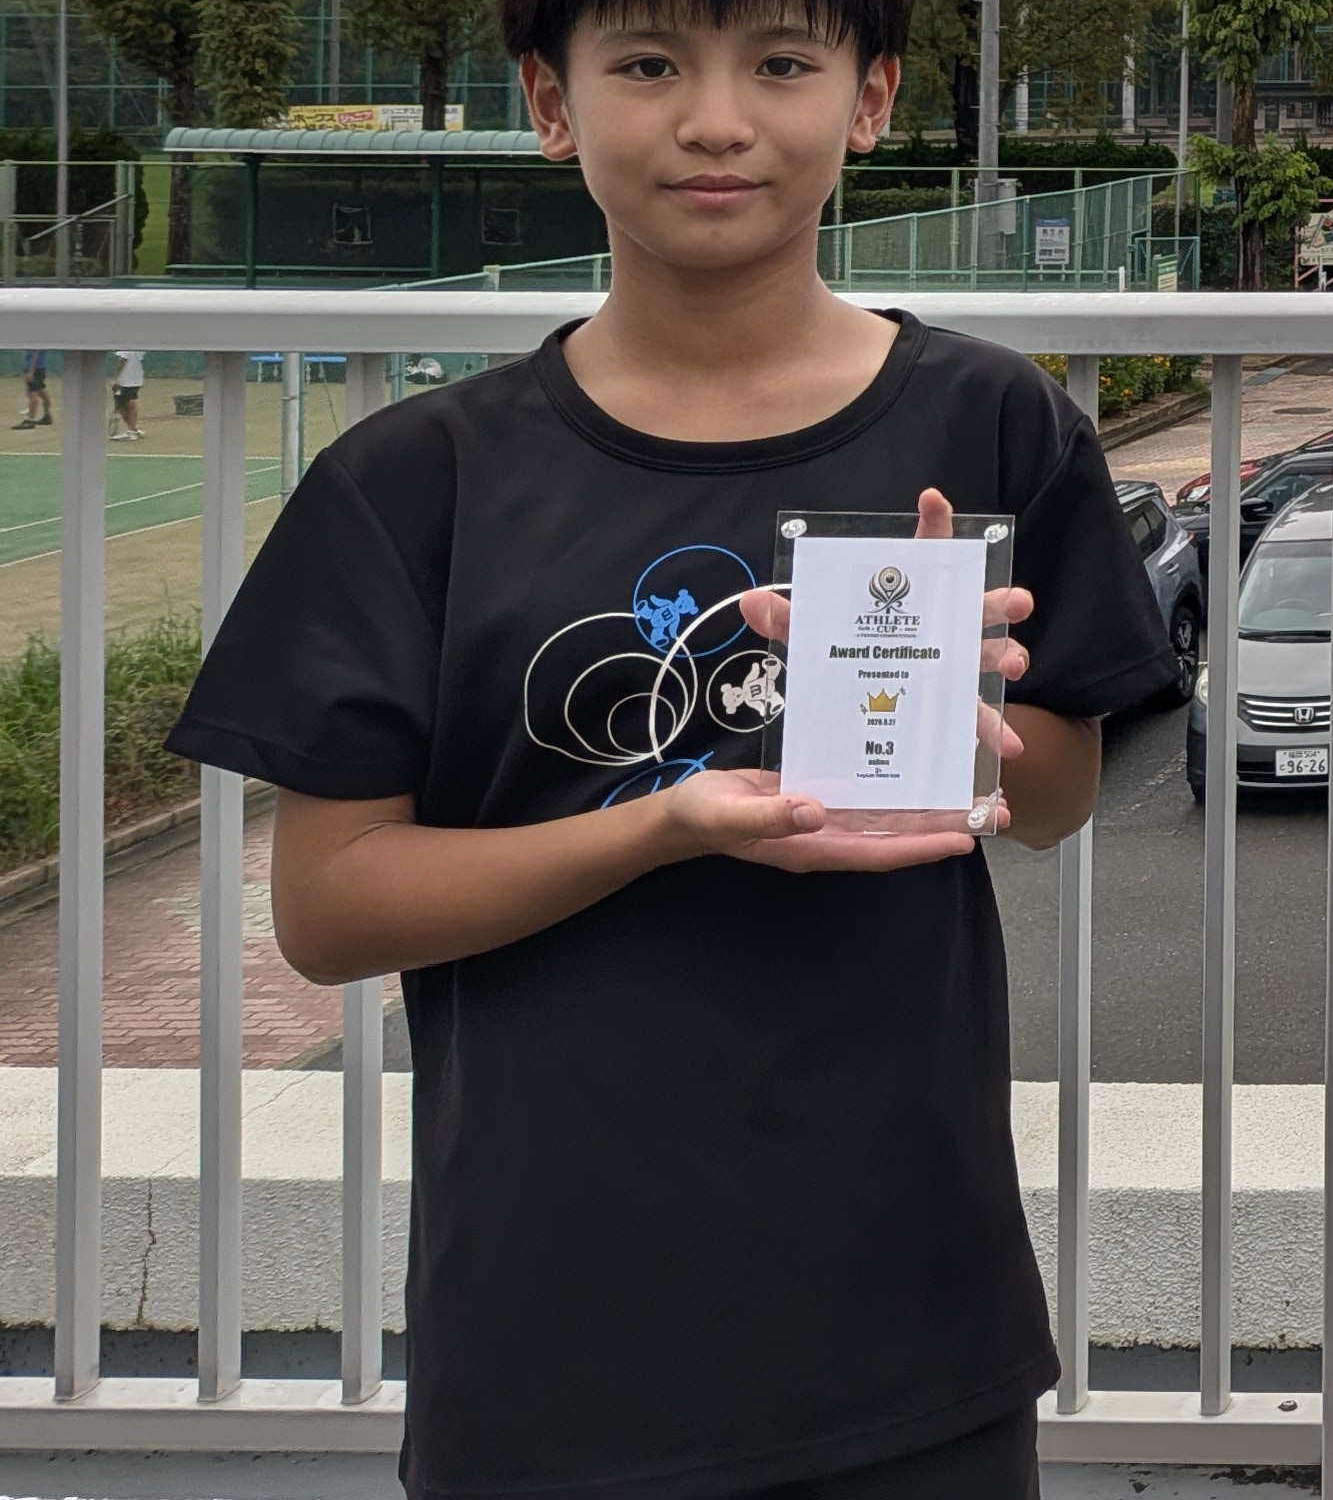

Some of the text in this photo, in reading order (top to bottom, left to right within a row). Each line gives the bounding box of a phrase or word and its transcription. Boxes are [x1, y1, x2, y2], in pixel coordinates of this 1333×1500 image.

[854, 614, 921, 626] ATHLETE
[876, 625, 898, 633] CUP
[829, 645, 941, 660] Award Certificate
[857, 669, 910, 679] Presented to
[865, 740, 894, 755] No.3
[1287, 759, 1326, 773] 96-26
